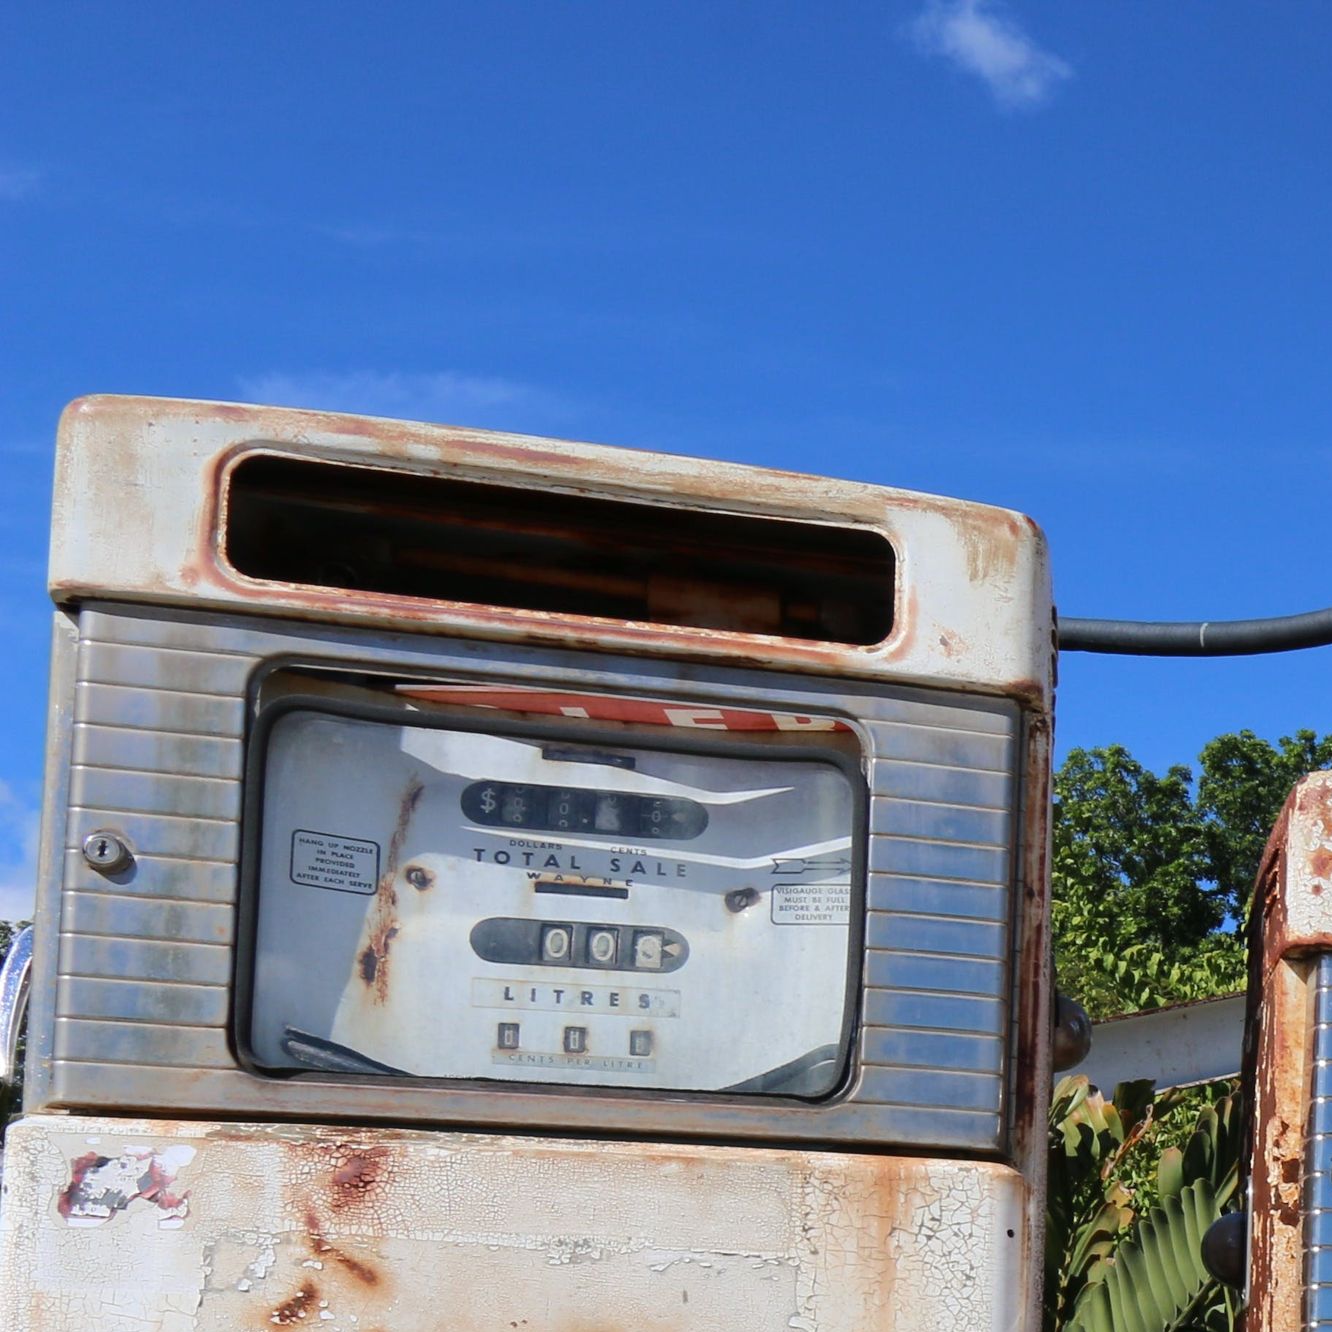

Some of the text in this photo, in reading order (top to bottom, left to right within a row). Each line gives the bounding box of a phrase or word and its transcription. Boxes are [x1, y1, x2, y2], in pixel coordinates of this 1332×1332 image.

[299, 838, 324, 847] HANG
[343, 845, 373, 855] NOZZLE
[509, 839, 648, 856] DOLLARS CENTS
[315, 857, 355, 868] PROVIDED
[331, 851, 354, 860] PLACE
[473, 848, 687, 877] TOTAL SALE
[308, 865, 360, 878] IMMEDIATELY
[527, 871, 634, 887] WAYNE
[296, 873, 373, 889] AFTER EACH SERVE
[775, 887, 824, 895] VISIGAUGE
[778, 904, 809, 912] BEFORE
[794, 913, 833, 921] DELIVERY
[504, 986, 651, 1009] LITRES
[508, 1054, 642, 1070] CENTS PER LITRE
